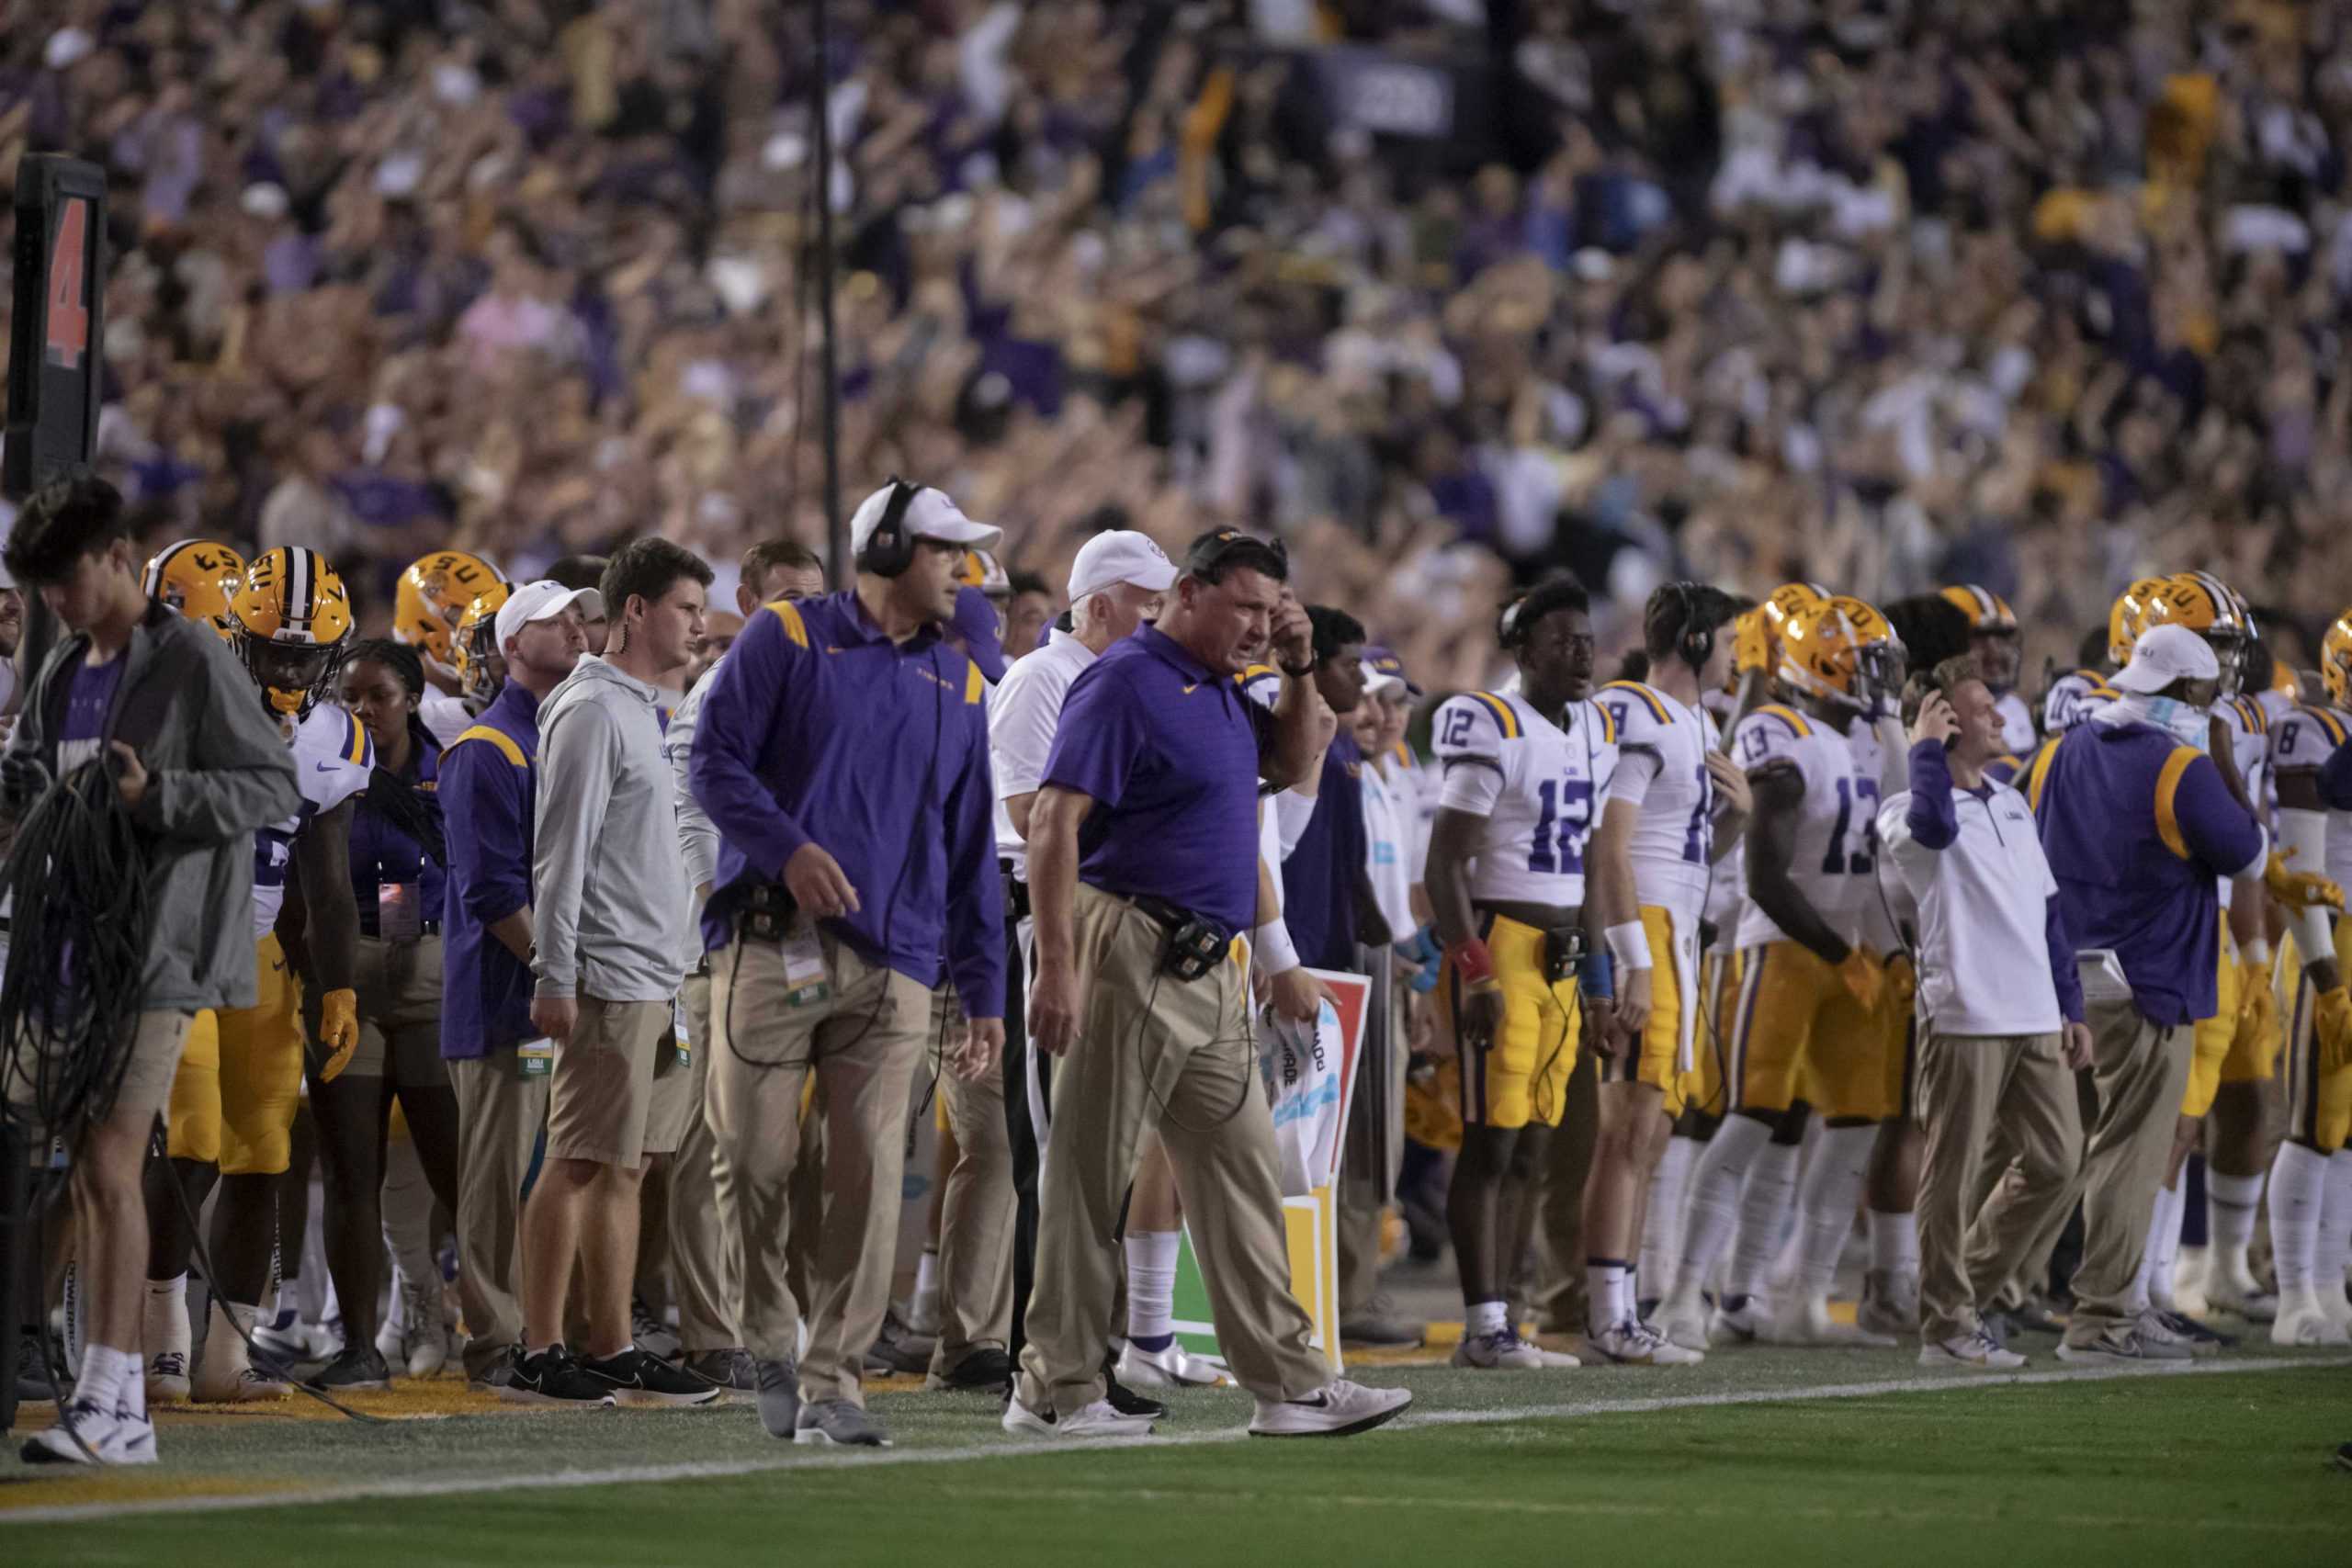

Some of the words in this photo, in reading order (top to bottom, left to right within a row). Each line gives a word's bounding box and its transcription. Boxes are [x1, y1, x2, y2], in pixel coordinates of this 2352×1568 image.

[47, 197, 89, 368] 4
[1442, 705, 1476, 748] 12
[2278, 721, 2301, 754] 8
[1528, 779, 1595, 874] 12
